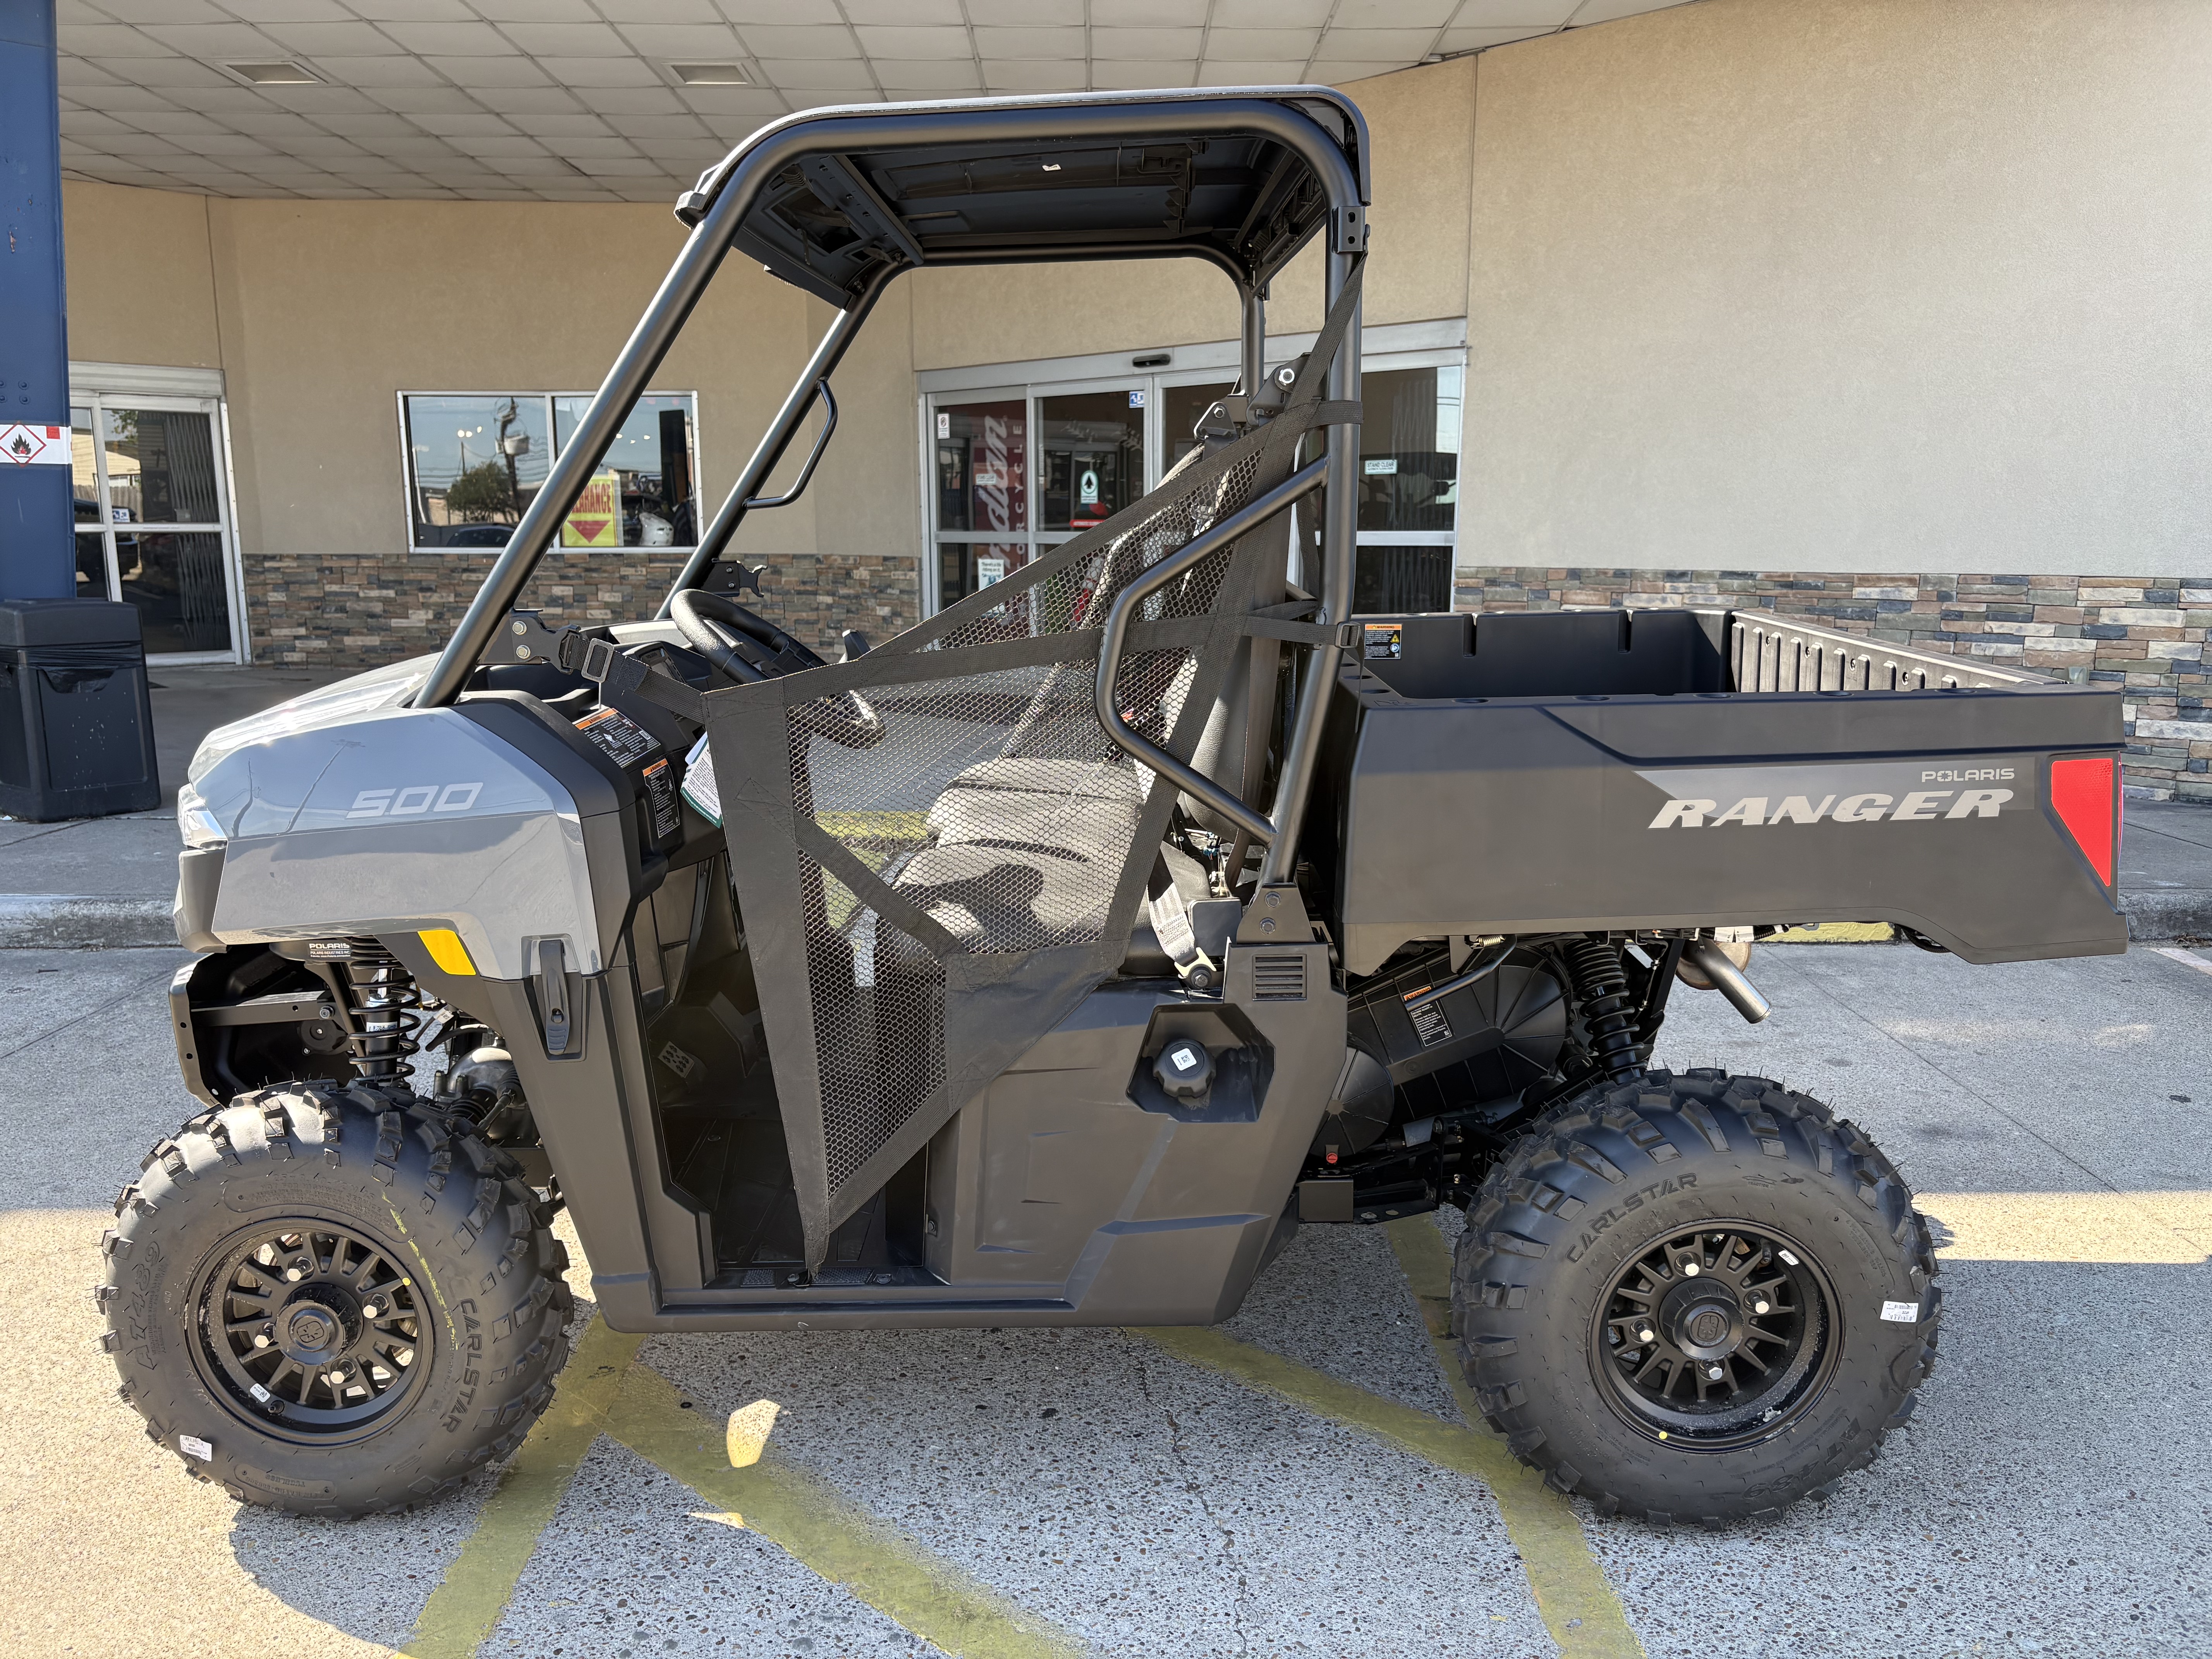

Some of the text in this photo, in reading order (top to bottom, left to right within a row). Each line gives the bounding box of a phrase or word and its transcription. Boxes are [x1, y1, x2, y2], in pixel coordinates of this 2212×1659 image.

[1922, 768, 2014, 782] POLARIS
[345, 782, 483, 819] 500
[1648, 788, 2014, 829] RANGER
[1565, 1172, 1698, 1264] CARLSTAR
[443, 1298, 481, 1435] CARLSTAR
